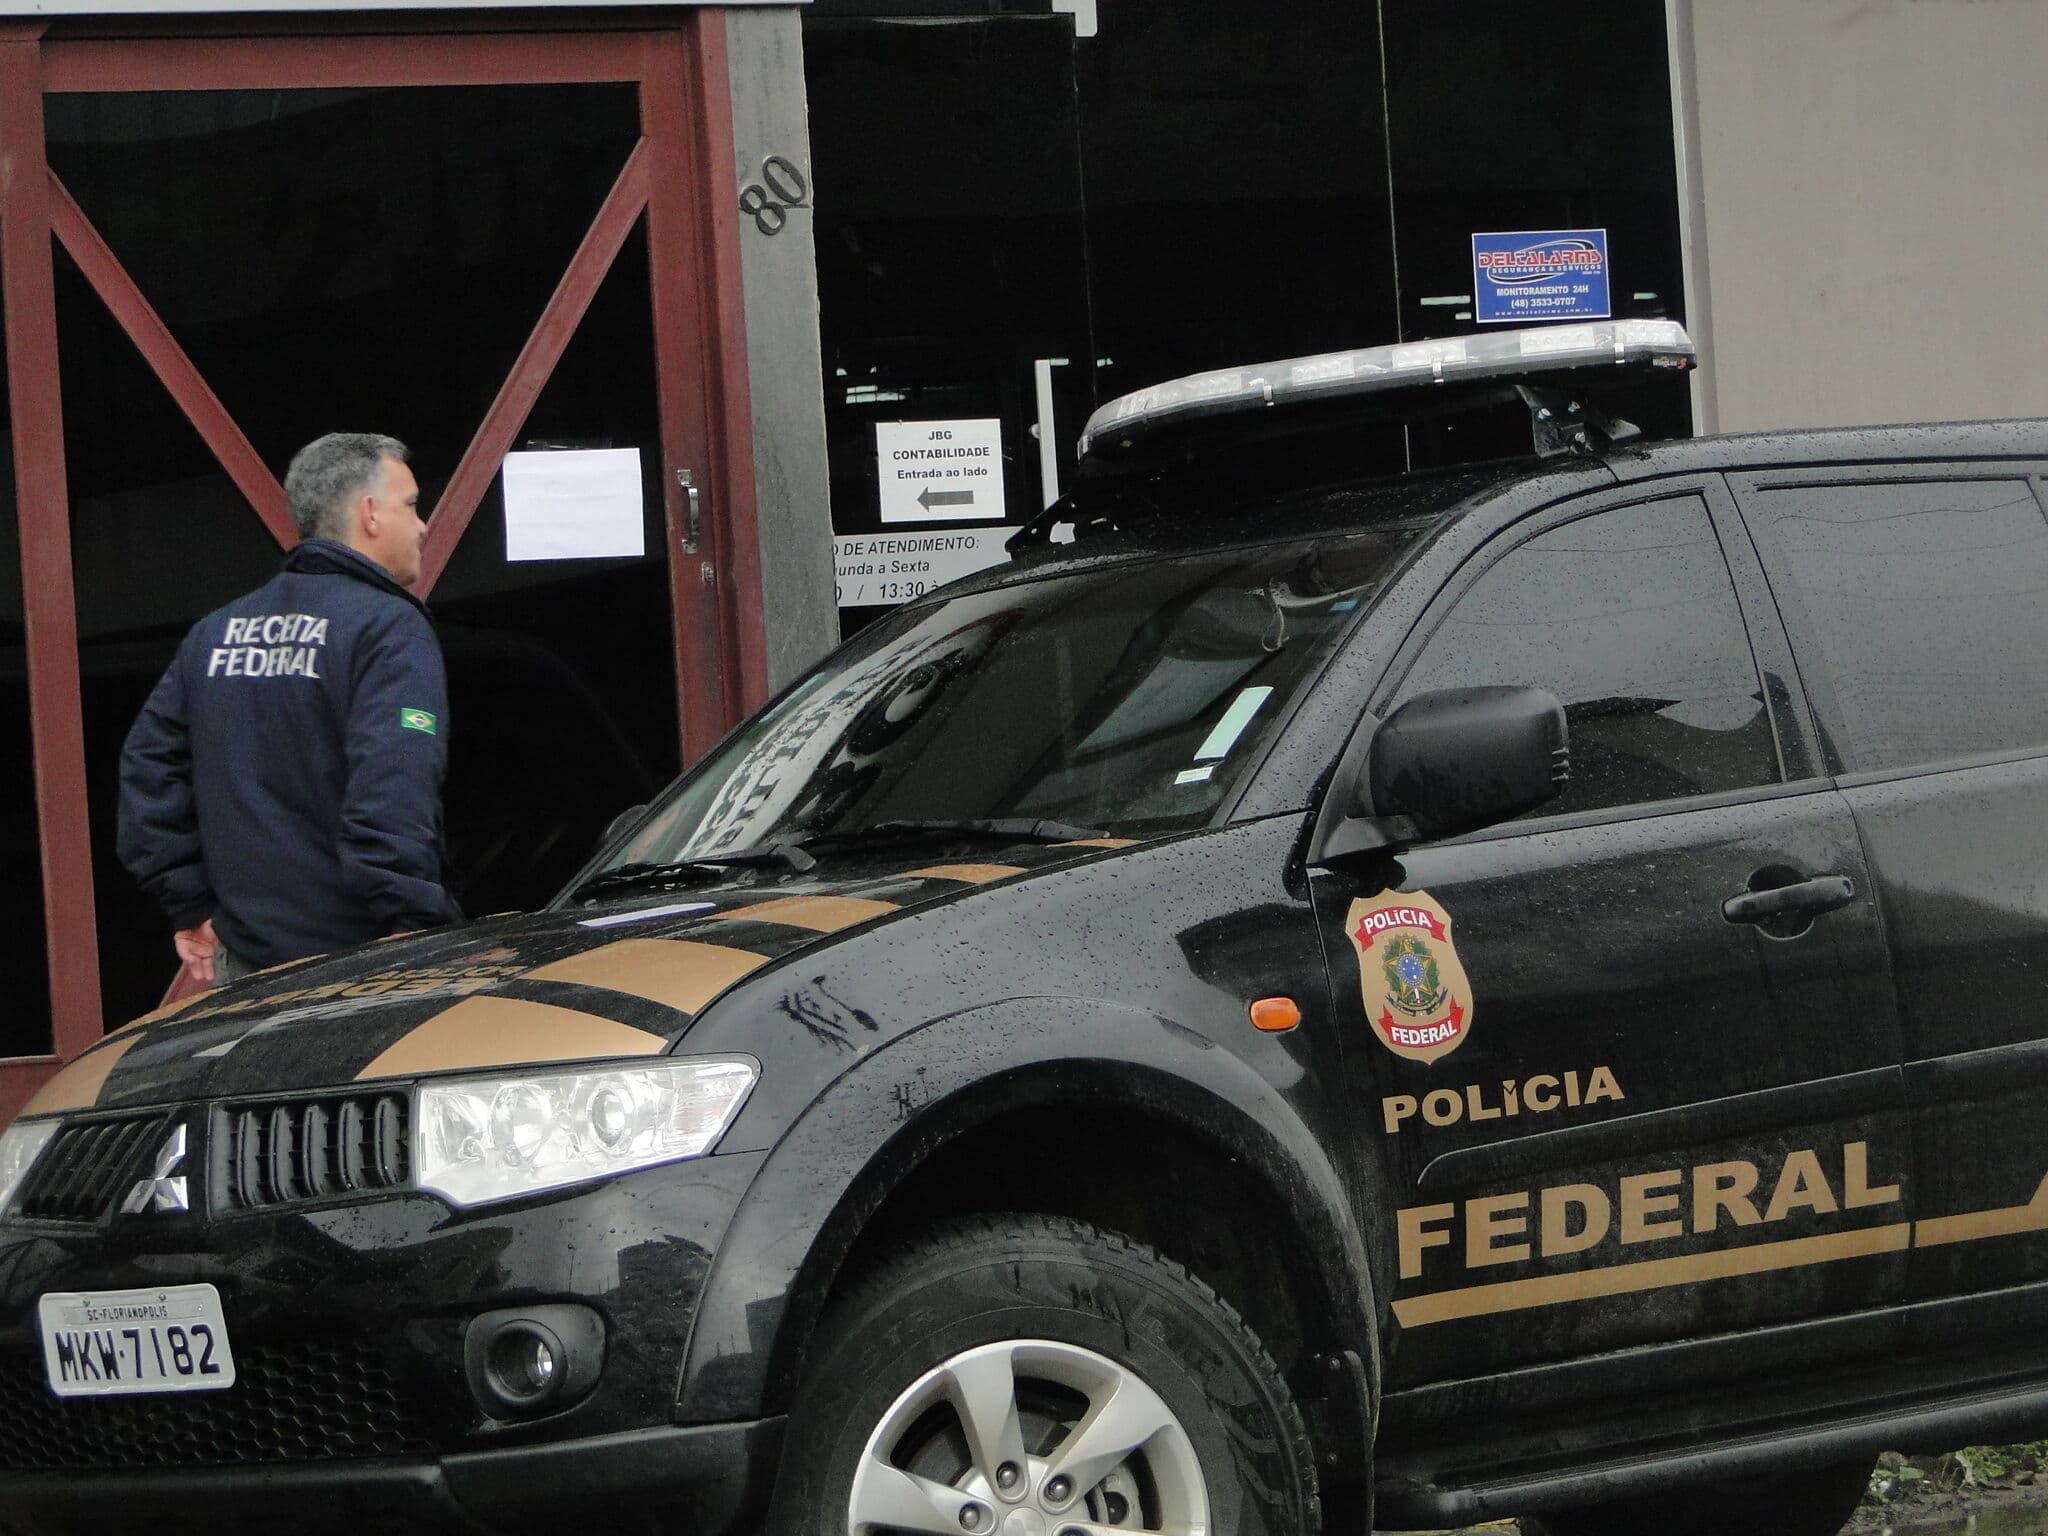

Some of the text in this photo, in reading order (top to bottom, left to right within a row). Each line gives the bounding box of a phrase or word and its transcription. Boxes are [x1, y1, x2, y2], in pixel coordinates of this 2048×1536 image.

[740, 155, 806, 235] 80
[1496, 284, 1589, 297] MONITORAMENTO 24H
[1511, 297, 1576, 309] (48) 3533-0707
[928, 431, 953, 441] JBG
[893, 447, 990, 461] CONTABILIDADE
[897, 467, 988, 480] Entrada ao lado
[843, 542, 864, 556] DE
[867, 536, 980, 555] ATENDIMENTO:
[878, 564, 886, 574] a
[891, 560, 930, 574] Sexta
[879, 581, 925, 599] 13:30
[207, 646, 321, 679] FEDERAL
[1391, 1020, 1458, 1045] FEDERAL
[1396, 1141, 1901, 1280] FEDERAL
